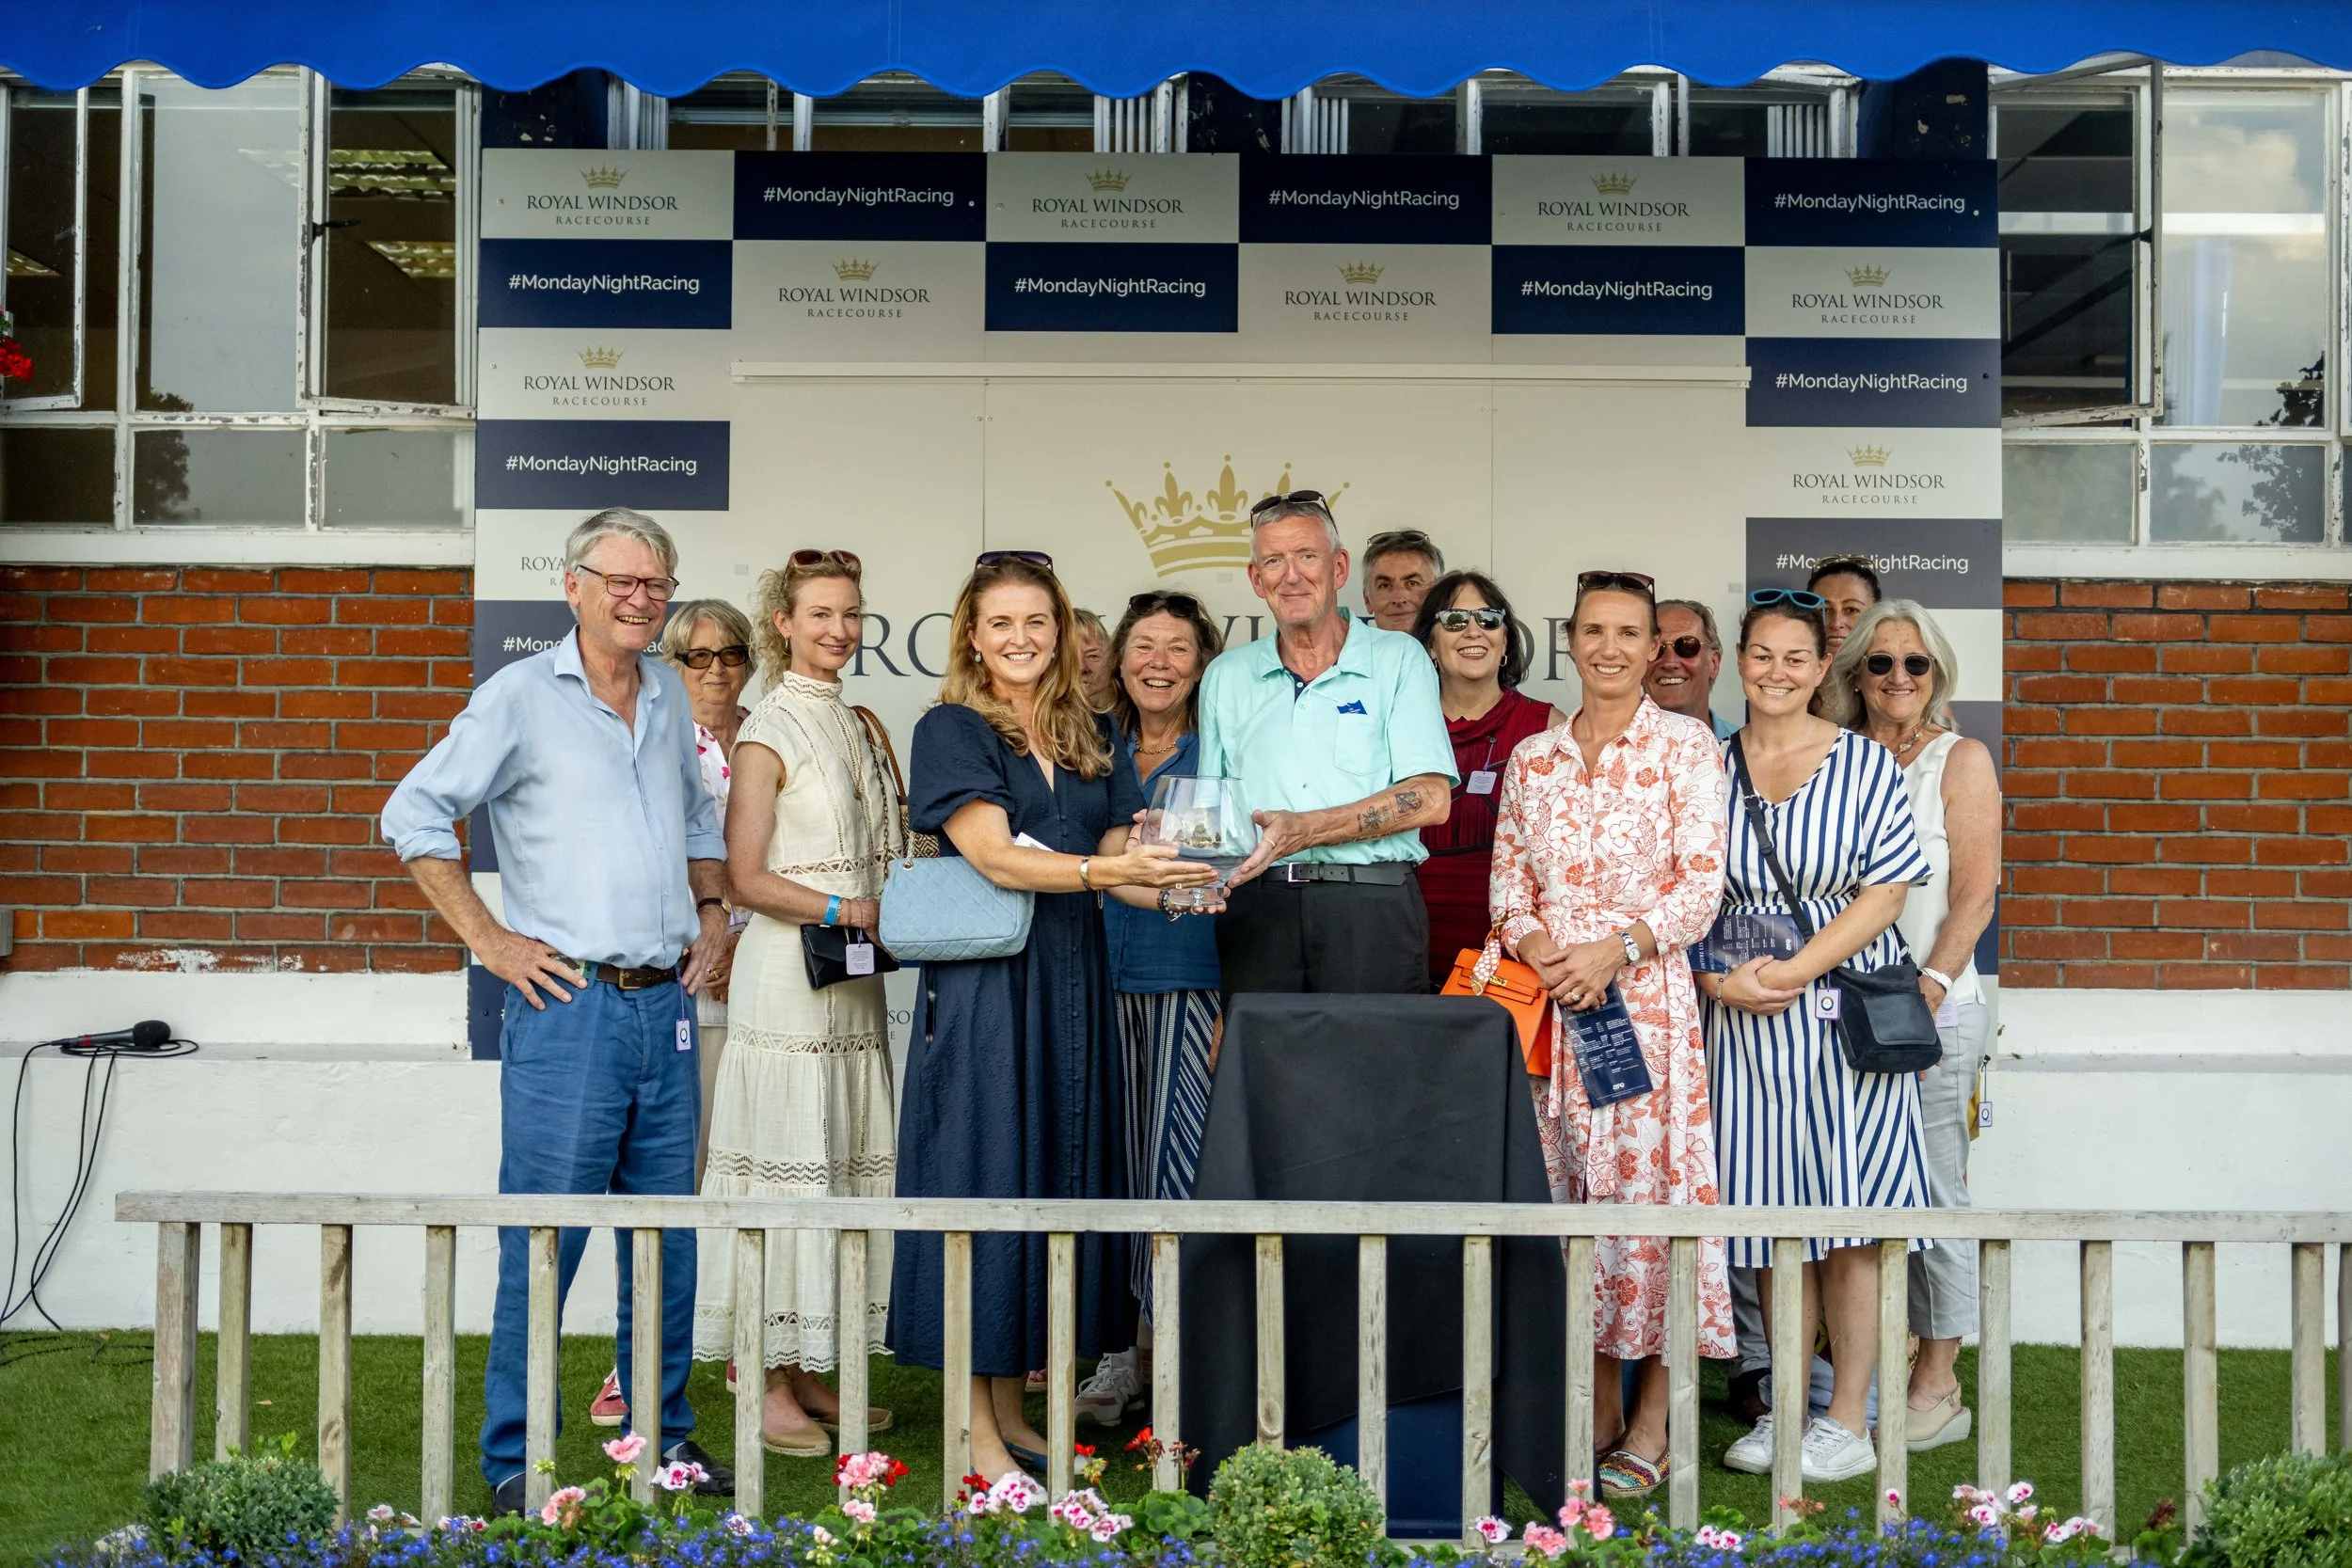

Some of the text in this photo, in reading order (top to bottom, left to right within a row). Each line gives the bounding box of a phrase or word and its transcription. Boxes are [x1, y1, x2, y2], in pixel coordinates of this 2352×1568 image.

[528, 196, 677, 210] ROYAL WINDSOR
[764, 187, 953, 206] #MondayNightRacing
[1269, 190, 1459, 210] #MondayNightRacing
[1774, 194, 1964, 213] #MondayNightRacing
[1033, 198, 1183, 213] ROYAL WINDSOR
[1539, 202, 1688, 215] ROYAL WINDSOR
[555, 215, 650, 226] RACECOURSE
[1060, 218, 1156, 229] RACECOURSE
[1566, 222, 1661, 232] RACECOURSE
[509, 275, 699, 293] #MondayNightRacing
[1015, 278, 1205, 297] #MondayNightRacing
[1521, 281, 1711, 300] #MondayNightRacing
[780, 288, 930, 302] ROYAL WINDSOR
[1286, 292, 1436, 306] ROYAL WINDSOR
[1793, 294, 1942, 309] ROYAL WINDSOR
[807, 309, 902, 318] RACECOURSE
[1313, 311, 1408, 322] RACECOURSE
[1821, 314, 1915, 325] RACECOURSE
[525, 376, 675, 390] ROYAL WINDSOR
[1776, 373, 1967, 393] #MondayNightRacing
[552, 396, 647, 406] RACECOURSE
[506, 456, 696, 475] #MondayNightRacing
[1794, 474, 1944, 488] ROYAL WINDSOR
[1822, 495, 1916, 504] RACECOURSE
[521, 557, 565, 571] ROYA
